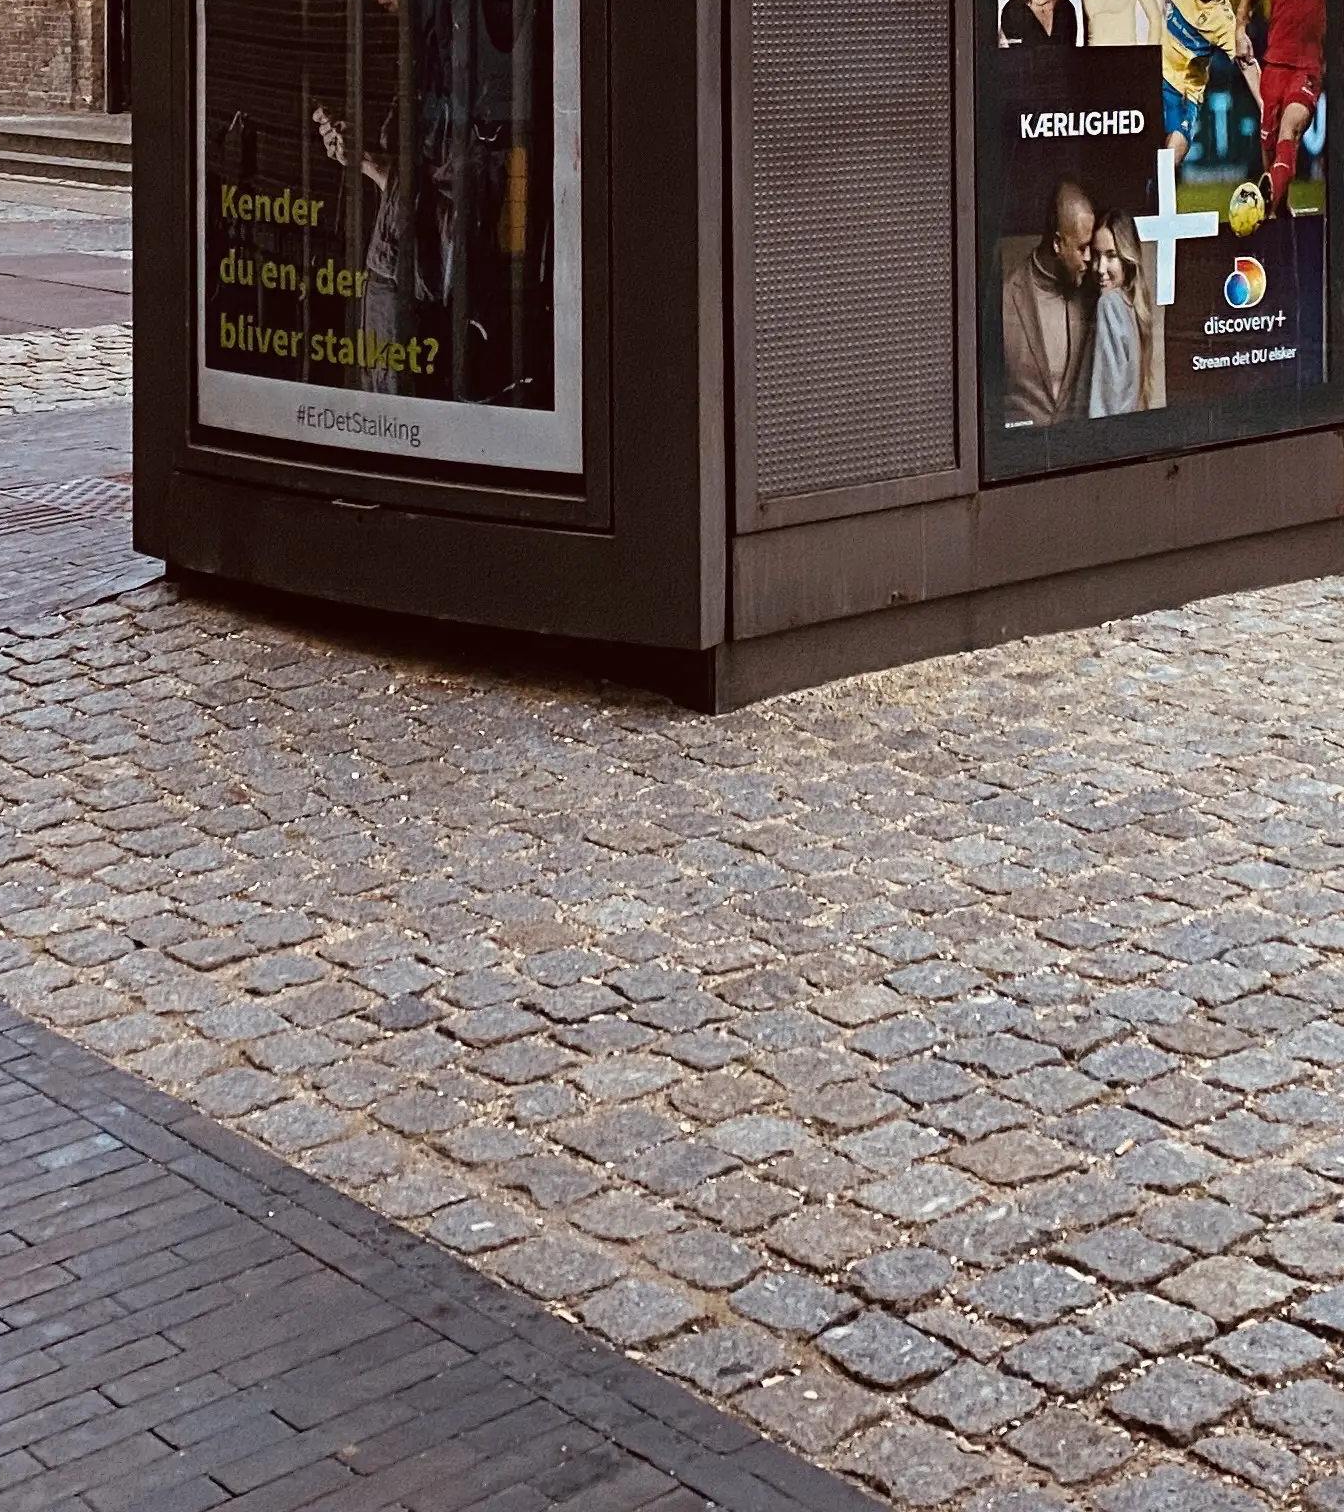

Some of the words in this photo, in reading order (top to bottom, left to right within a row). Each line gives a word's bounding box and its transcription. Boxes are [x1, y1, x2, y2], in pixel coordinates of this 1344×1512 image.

[1020, 109, 1145, 139] KÆRLIGHED
[221, 183, 325, 227] Kender
[219, 248, 255, 286] du
[261, 261, 306, 301] en,
[316, 258, 369, 299] der
[220, 312, 304, 357] bliver
[311, 328, 439, 375] stalket?
[1204, 310, 1287, 336] discovery+
[1192, 355, 1231, 371] Stream
[1232, 351, 1251, 366] det
[1251, 348, 1268, 364] DU
[1268, 346, 1297, 361] elsker
[296, 404, 421, 449] #ErDetStalking
